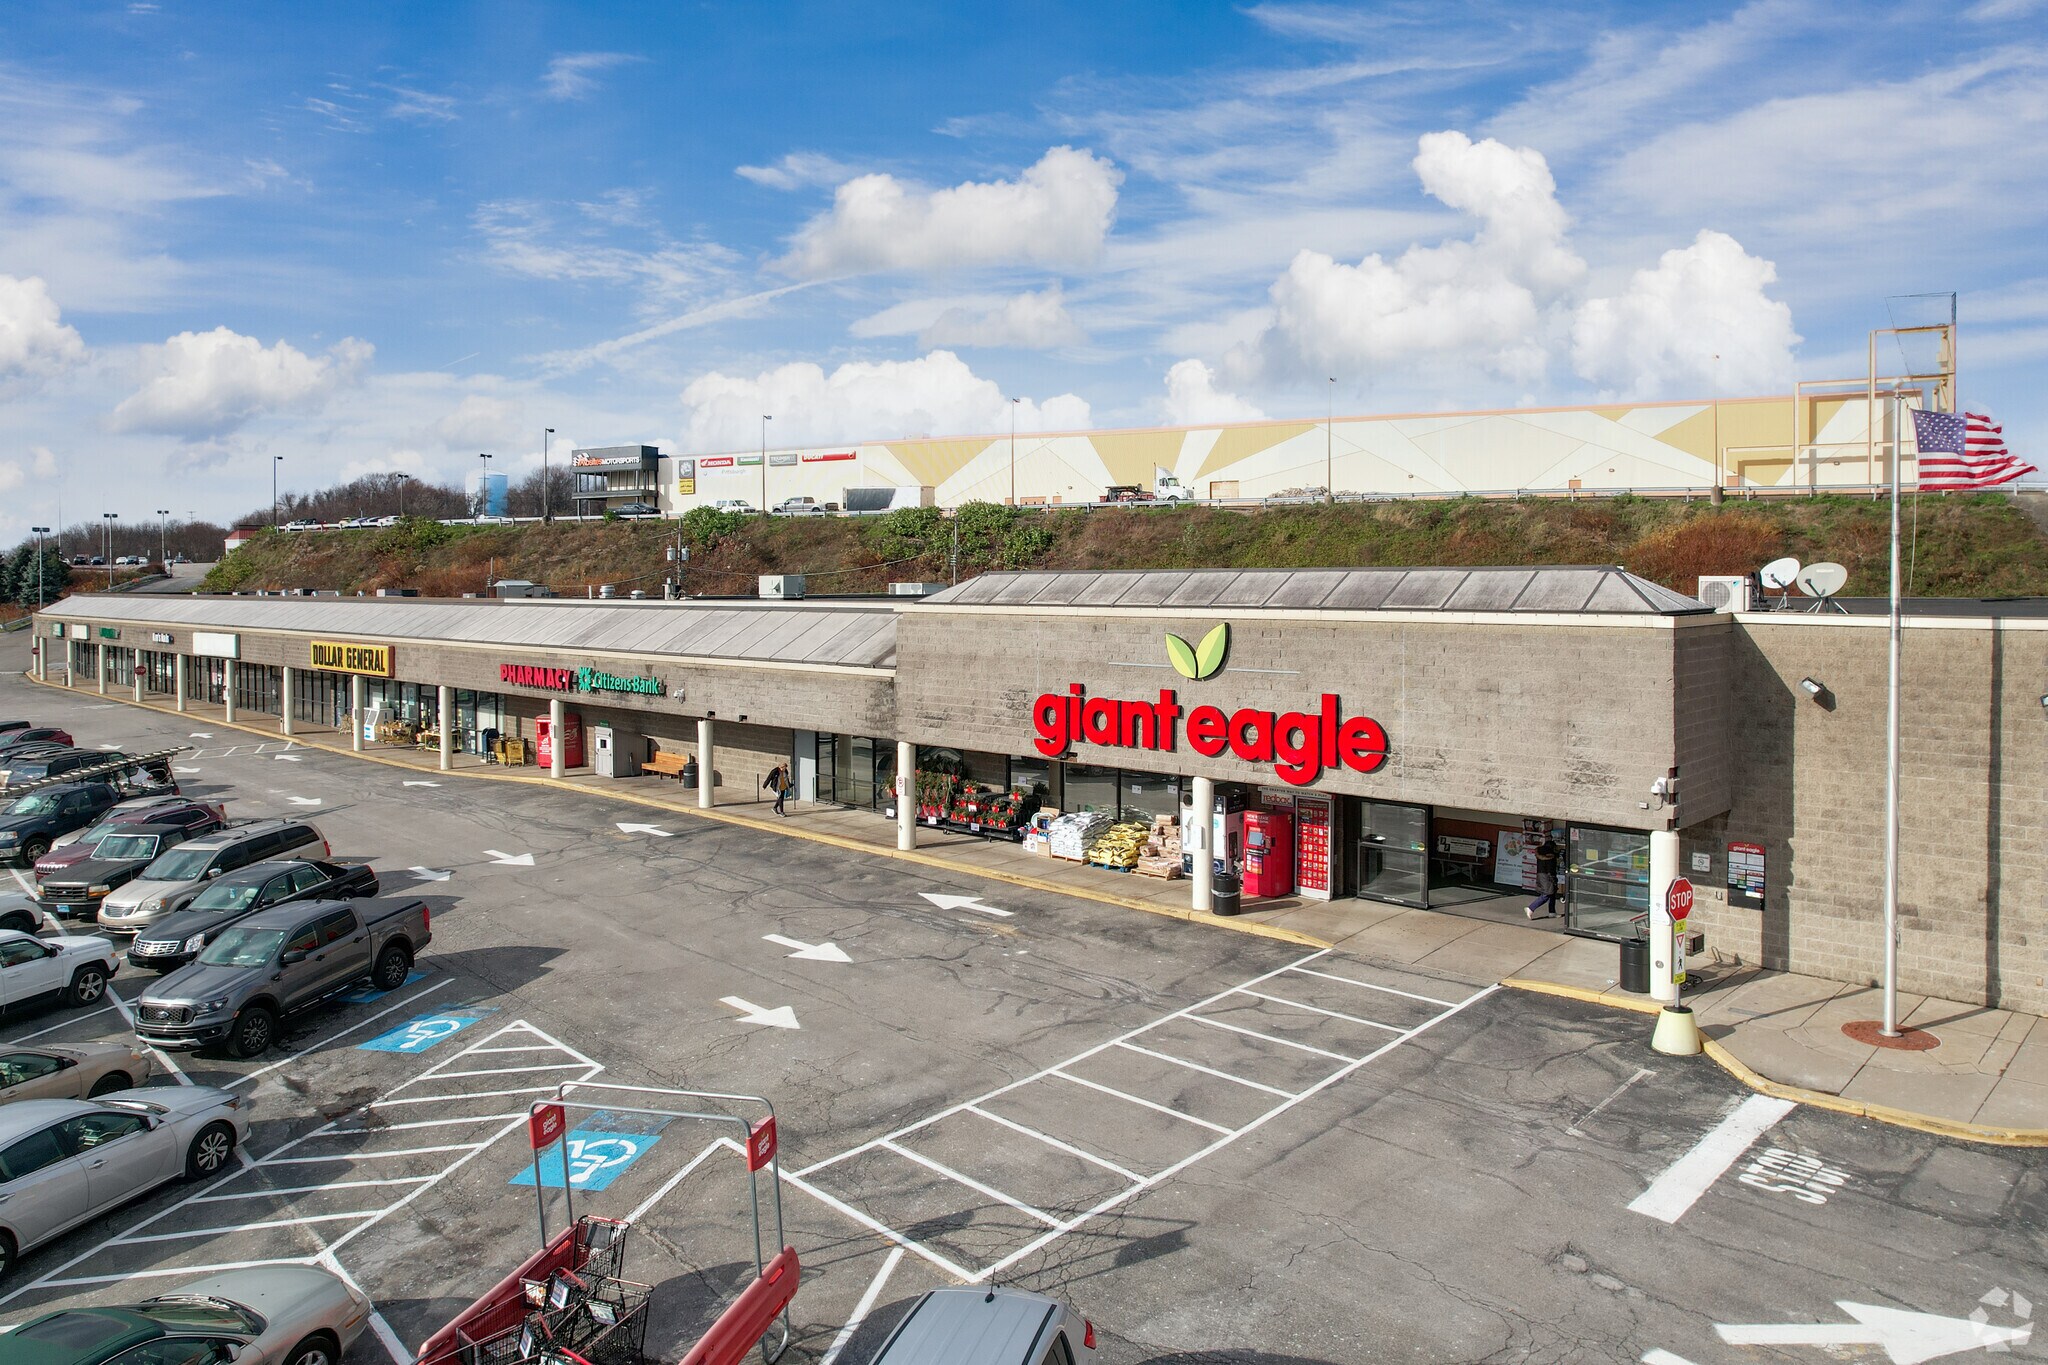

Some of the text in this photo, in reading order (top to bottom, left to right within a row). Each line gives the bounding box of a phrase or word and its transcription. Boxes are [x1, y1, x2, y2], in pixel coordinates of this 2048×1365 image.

[602, 456, 640, 465] MOTORSPORTS
[312, 644, 386, 672] DOLLAR GENERAL
[500, 664, 571, 689] PHARMACY
[594, 672, 661, 695] Citizens Bank
[1033, 682, 1387, 785] giant eagle
[1263, 794, 1290, 803] redbox
[1671, 890, 1692, 910] STOP
[543, 1113, 557, 1129] giant
[543, 1121, 558, 1135] eagle
[1738, 1147, 1851, 1205] STOP
